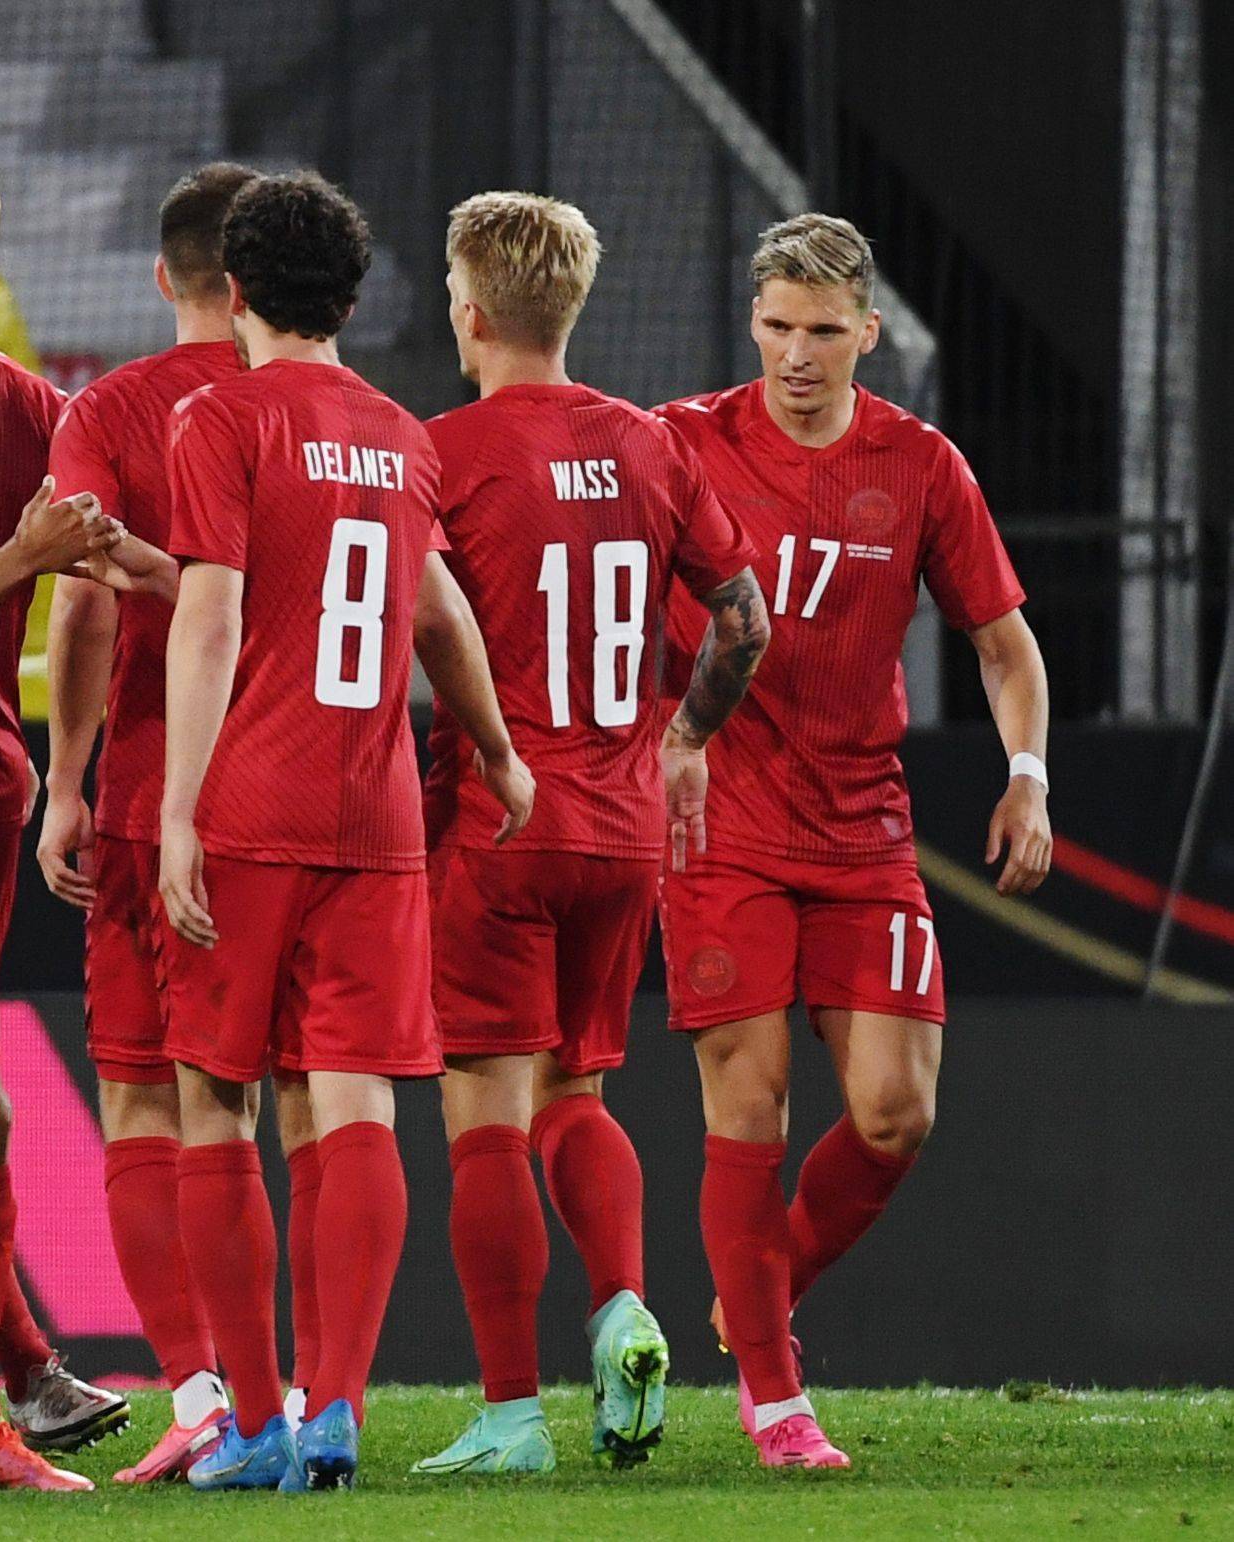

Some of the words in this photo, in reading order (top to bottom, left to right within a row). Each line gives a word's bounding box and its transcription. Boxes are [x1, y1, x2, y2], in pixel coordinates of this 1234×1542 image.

[302, 441, 405, 492] DELANEY
[549, 458, 619, 501] WASS
[314, 517, 389, 710] 8
[773, 534, 841, 619] 17
[536, 540, 649, 728] 18
[888, 911, 935, 996] 17
